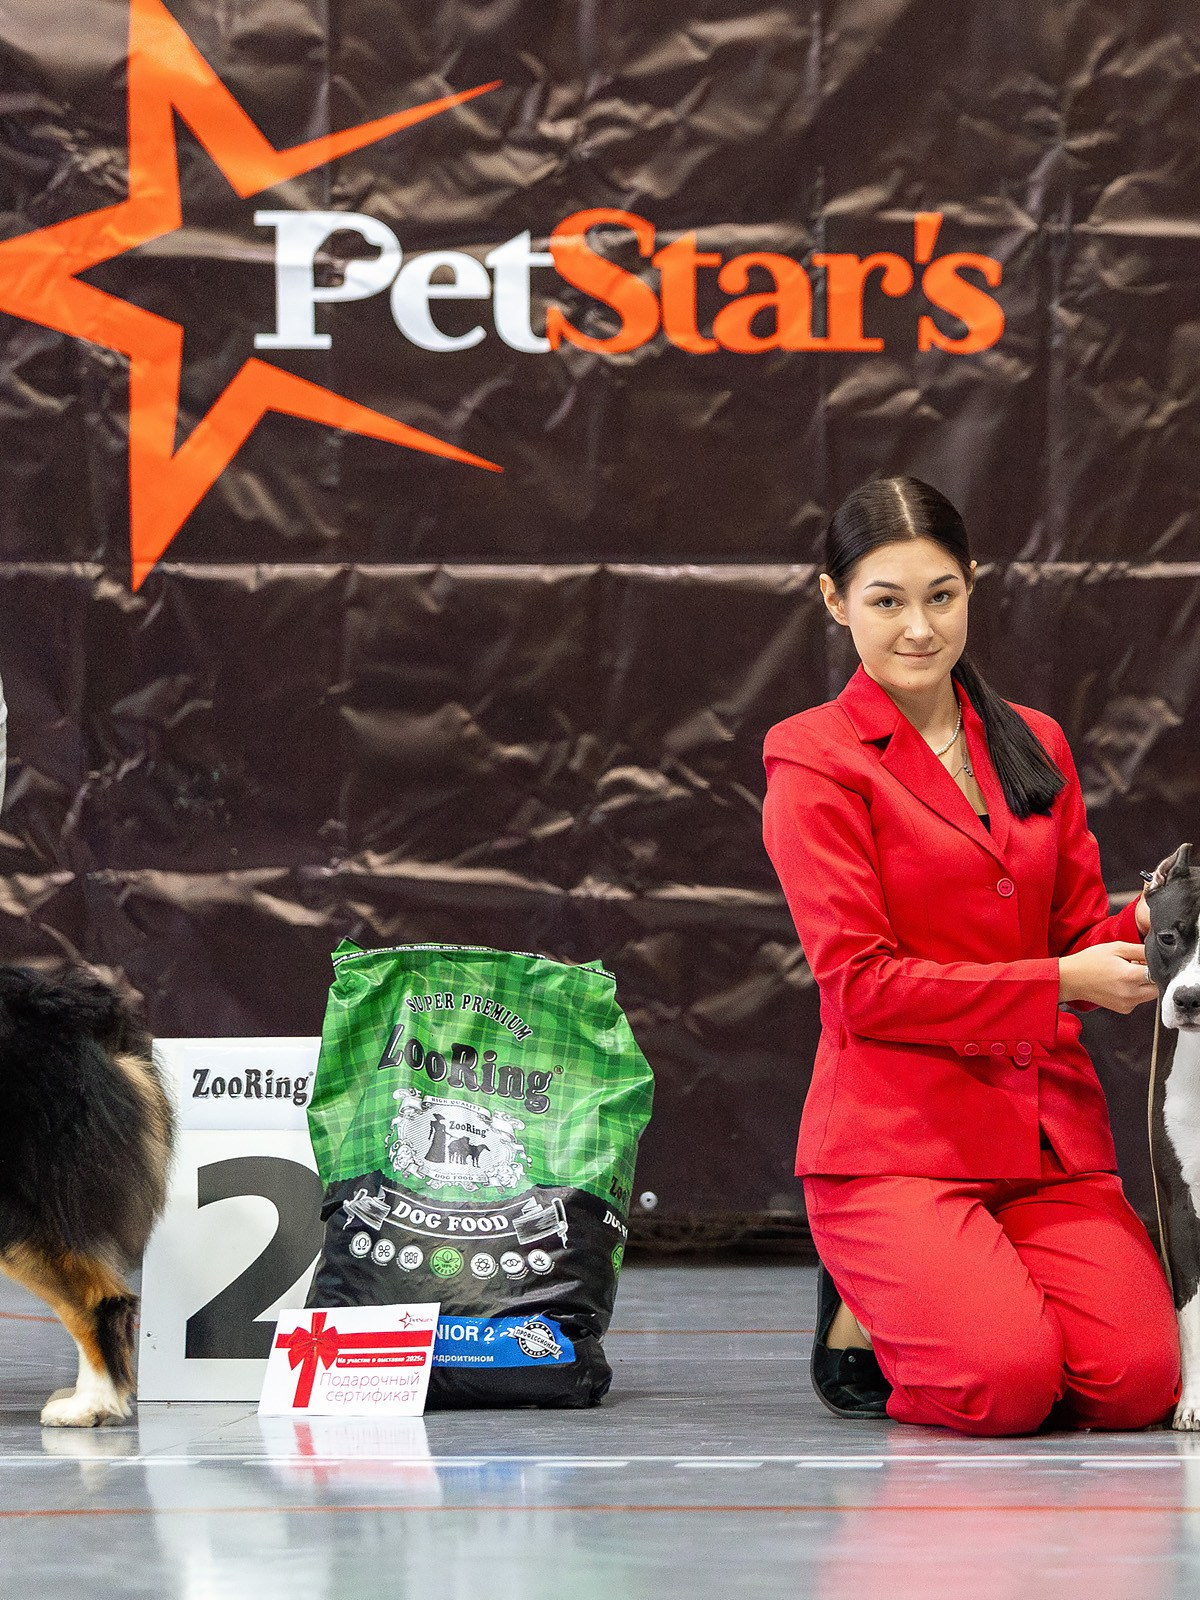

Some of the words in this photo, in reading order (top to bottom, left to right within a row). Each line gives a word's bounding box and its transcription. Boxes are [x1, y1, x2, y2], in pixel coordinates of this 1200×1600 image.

[254, 208, 1005, 355] PetStar's
[405, 992, 454, 1013] SUPER
[461, 993, 533, 1042] PREMIUM
[391, 1200, 442, 1229] DOG
[447, 1215, 509, 1232] FOOD
[185, 1156, 325, 1360] 2
[483, 1326, 495, 1342] 2
[515, 1327, 558, 1352] ПРОФЕССИОНАЛ
[319, 1371, 420, 1389] Подарочный
[325, 1388, 418, 1404] сертификат
